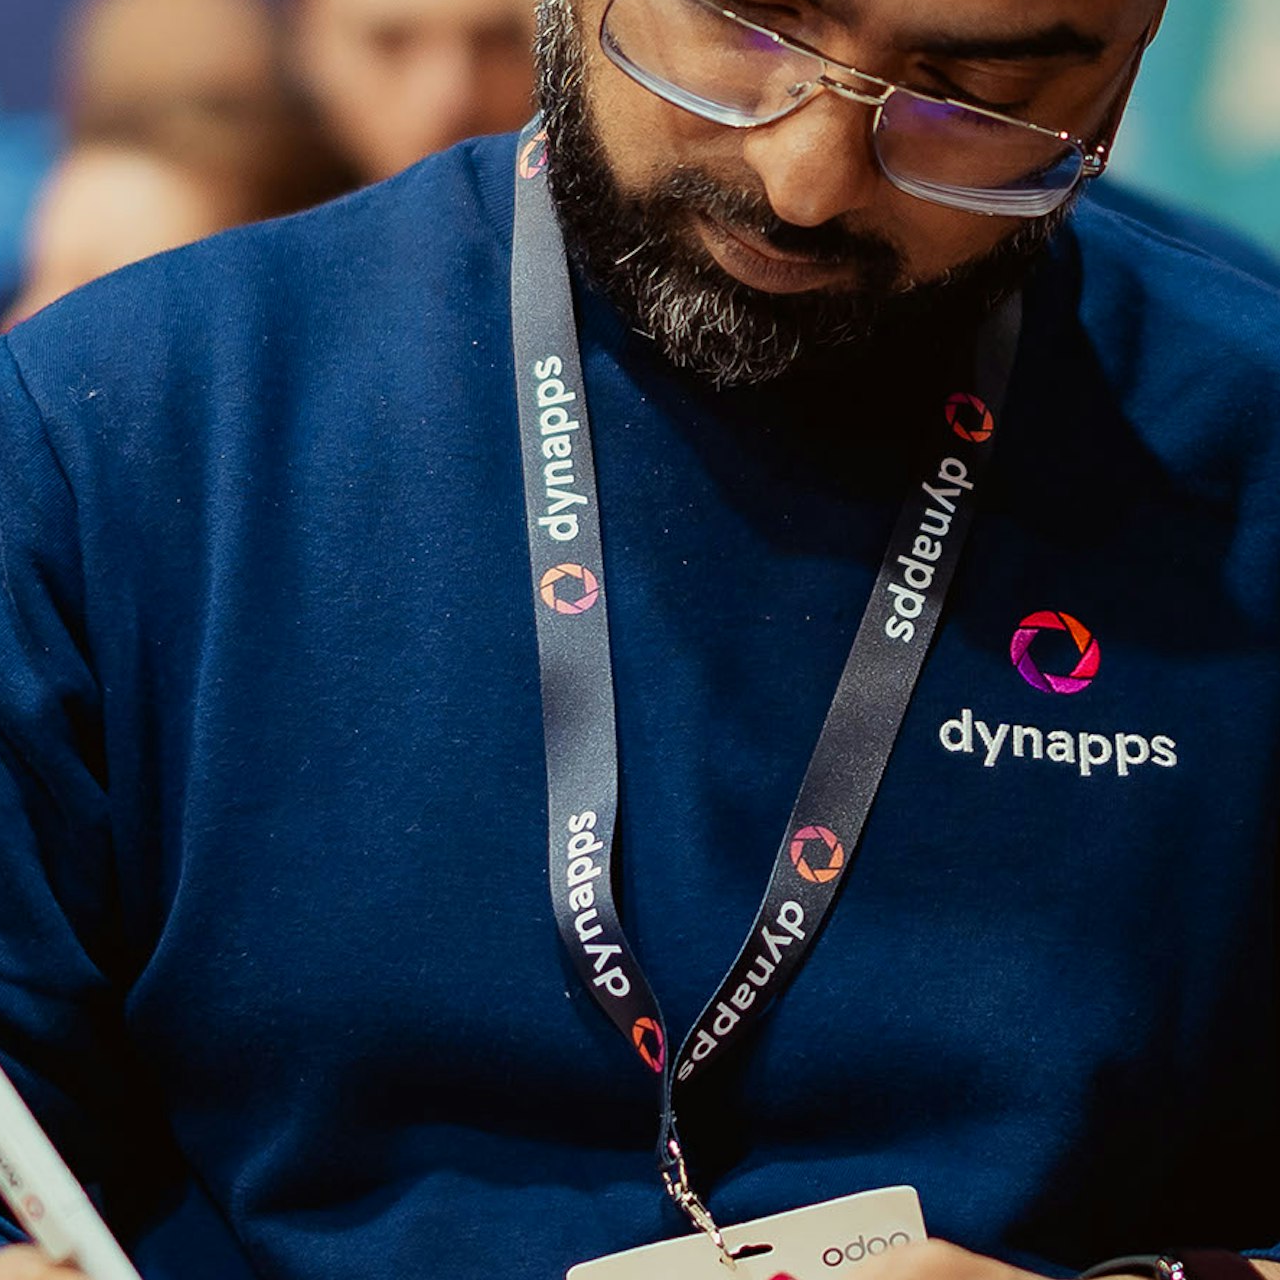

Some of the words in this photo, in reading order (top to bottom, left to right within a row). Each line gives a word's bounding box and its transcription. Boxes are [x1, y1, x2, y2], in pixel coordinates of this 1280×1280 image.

[534, 355, 588, 541] dynapps
[885, 457, 974, 643] dynapps
[939, 708, 1178, 776] dynapps
[567, 810, 631, 997] dynapps
[676, 900, 806, 1081] dynapps
